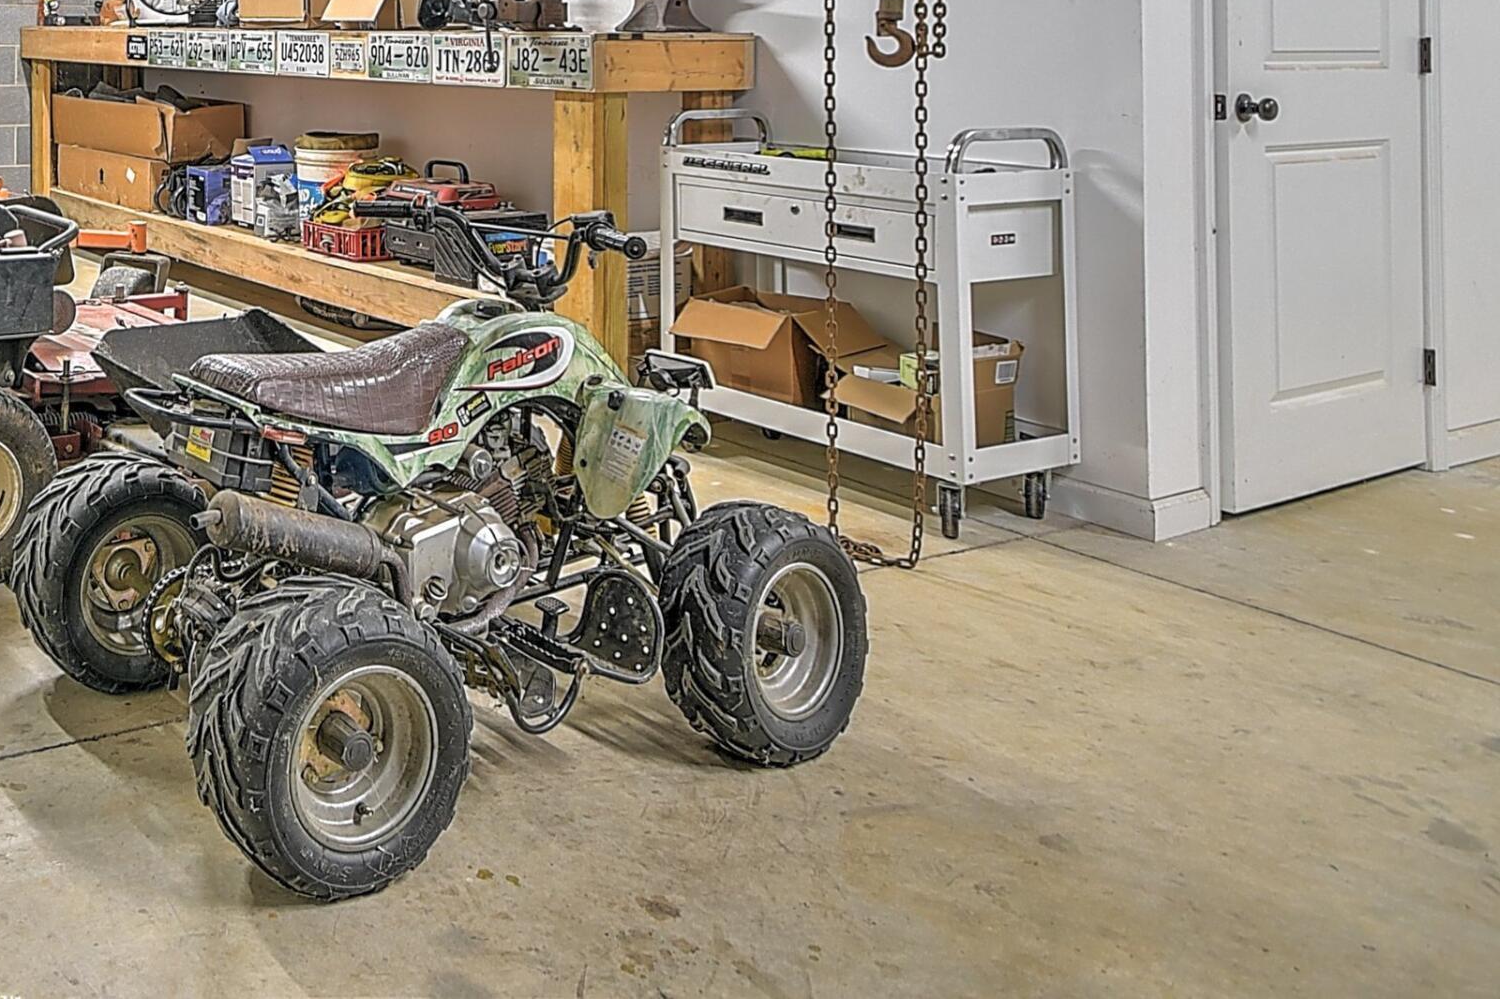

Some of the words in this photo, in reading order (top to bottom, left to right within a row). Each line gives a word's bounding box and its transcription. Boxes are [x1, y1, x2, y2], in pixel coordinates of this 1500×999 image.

[280, 42, 325, 64] U452038
[450, 37, 485, 48] VIRGINIA
[512, 48, 588, 73] J82-43E
[487, 335, 561, 381] Falcon
[428, 421, 459, 446] 90
